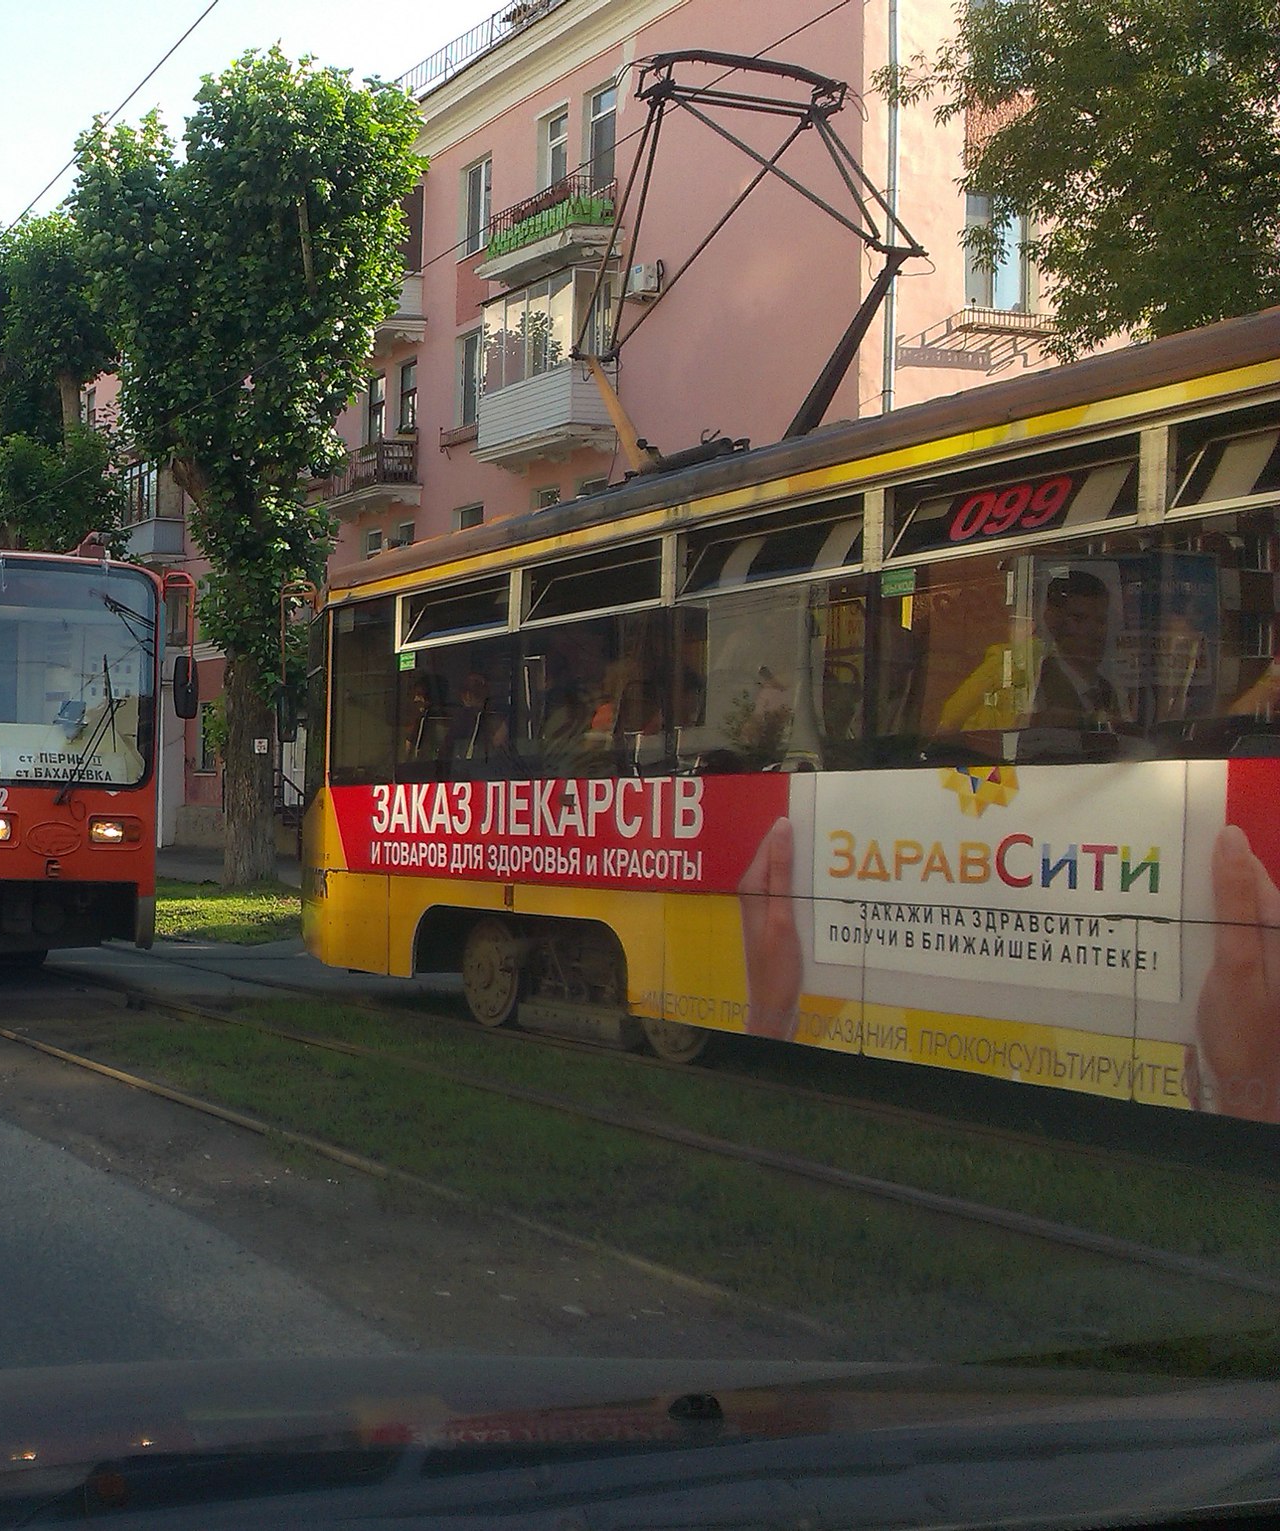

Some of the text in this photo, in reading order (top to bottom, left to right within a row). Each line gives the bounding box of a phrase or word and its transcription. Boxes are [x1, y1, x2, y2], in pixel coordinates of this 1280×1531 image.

[949, 476, 1073, 541] 099
[370, 776, 705, 839] ЗАКАЗ ЛЕКАРСТВ
[370, 841, 381, 865] И
[383, 842, 448, 869] ТОВАРОВ
[449, 844, 484, 874] ДЛЯ
[487, 844, 581, 877] ЗДОРОВЬЯ
[603, 849, 703, 882] КРАСОТЫ
[859, 901, 934, 926] ЗАКАЖИ
[941, 906, 966, 928] НА
[972, 910, 1101, 938] ЗДРАВСИТИ
[829, 925, 1158, 971] ПОЛУЧИ В БЛИЖАЙШЕЙ АПТЕКЕ!
